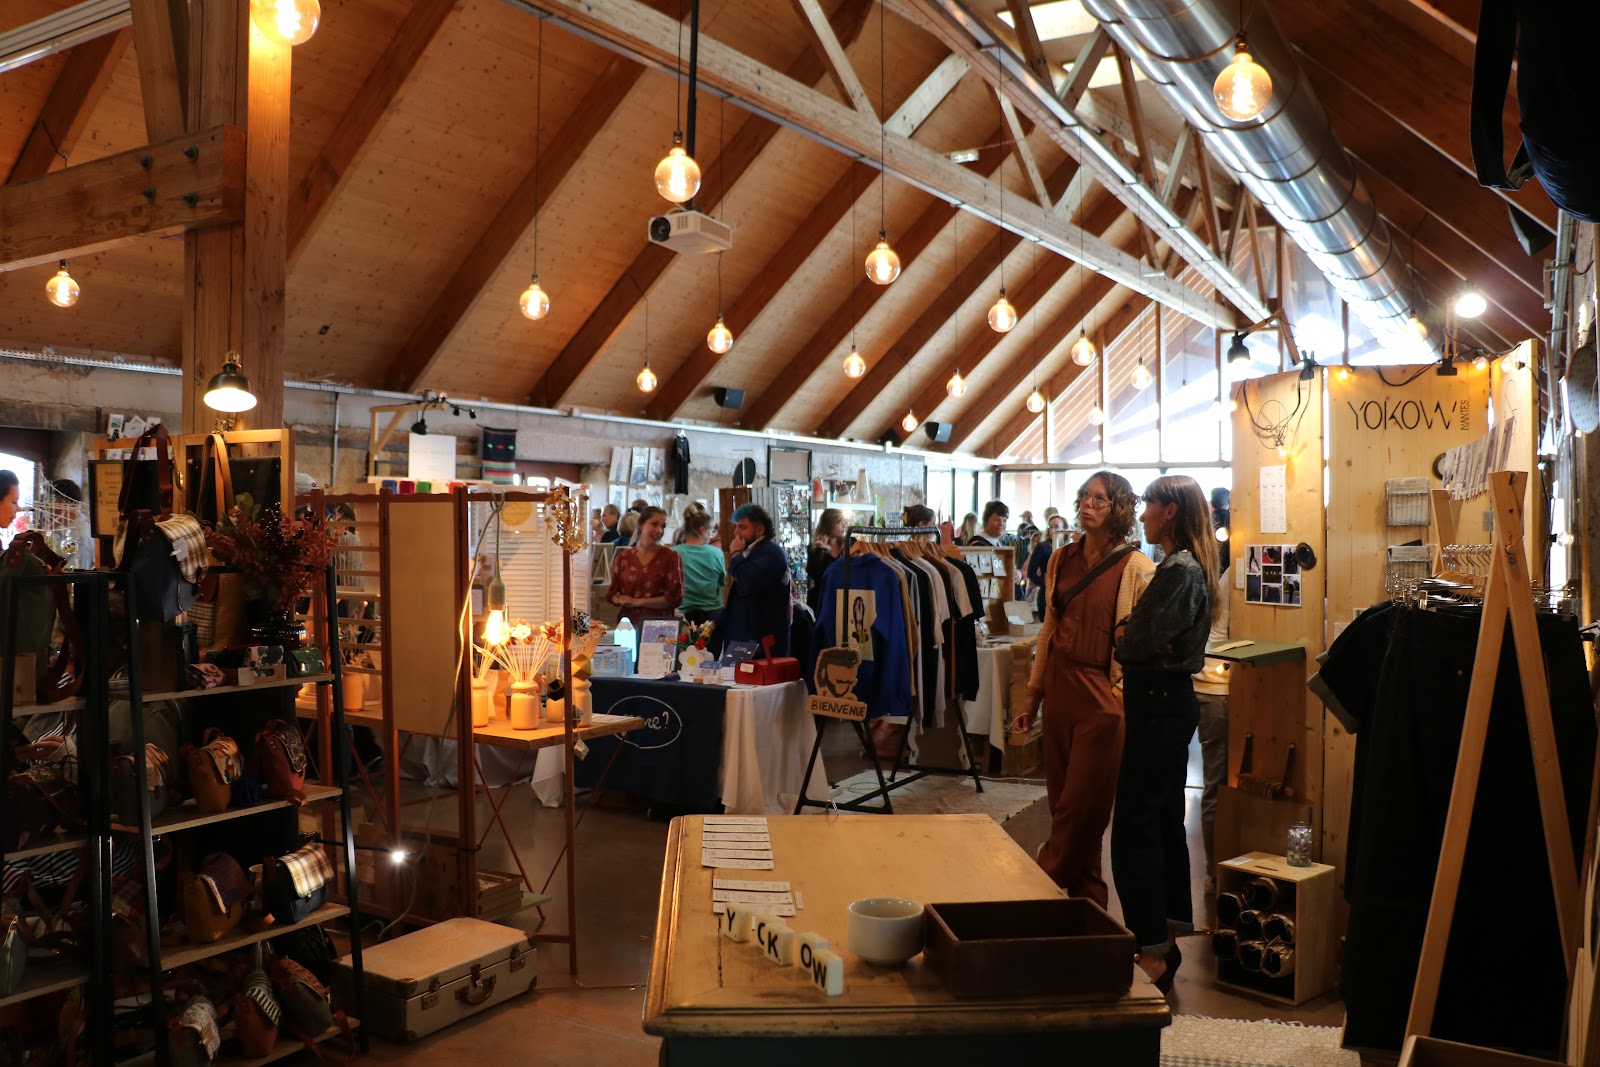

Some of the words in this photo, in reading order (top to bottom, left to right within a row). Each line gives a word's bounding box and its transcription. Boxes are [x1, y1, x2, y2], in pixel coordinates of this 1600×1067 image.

[1347, 400, 1457, 430] YOKOW
[1460, 399, 1470, 431] NANTES
[811, 700, 866, 717] BIENVENUE
